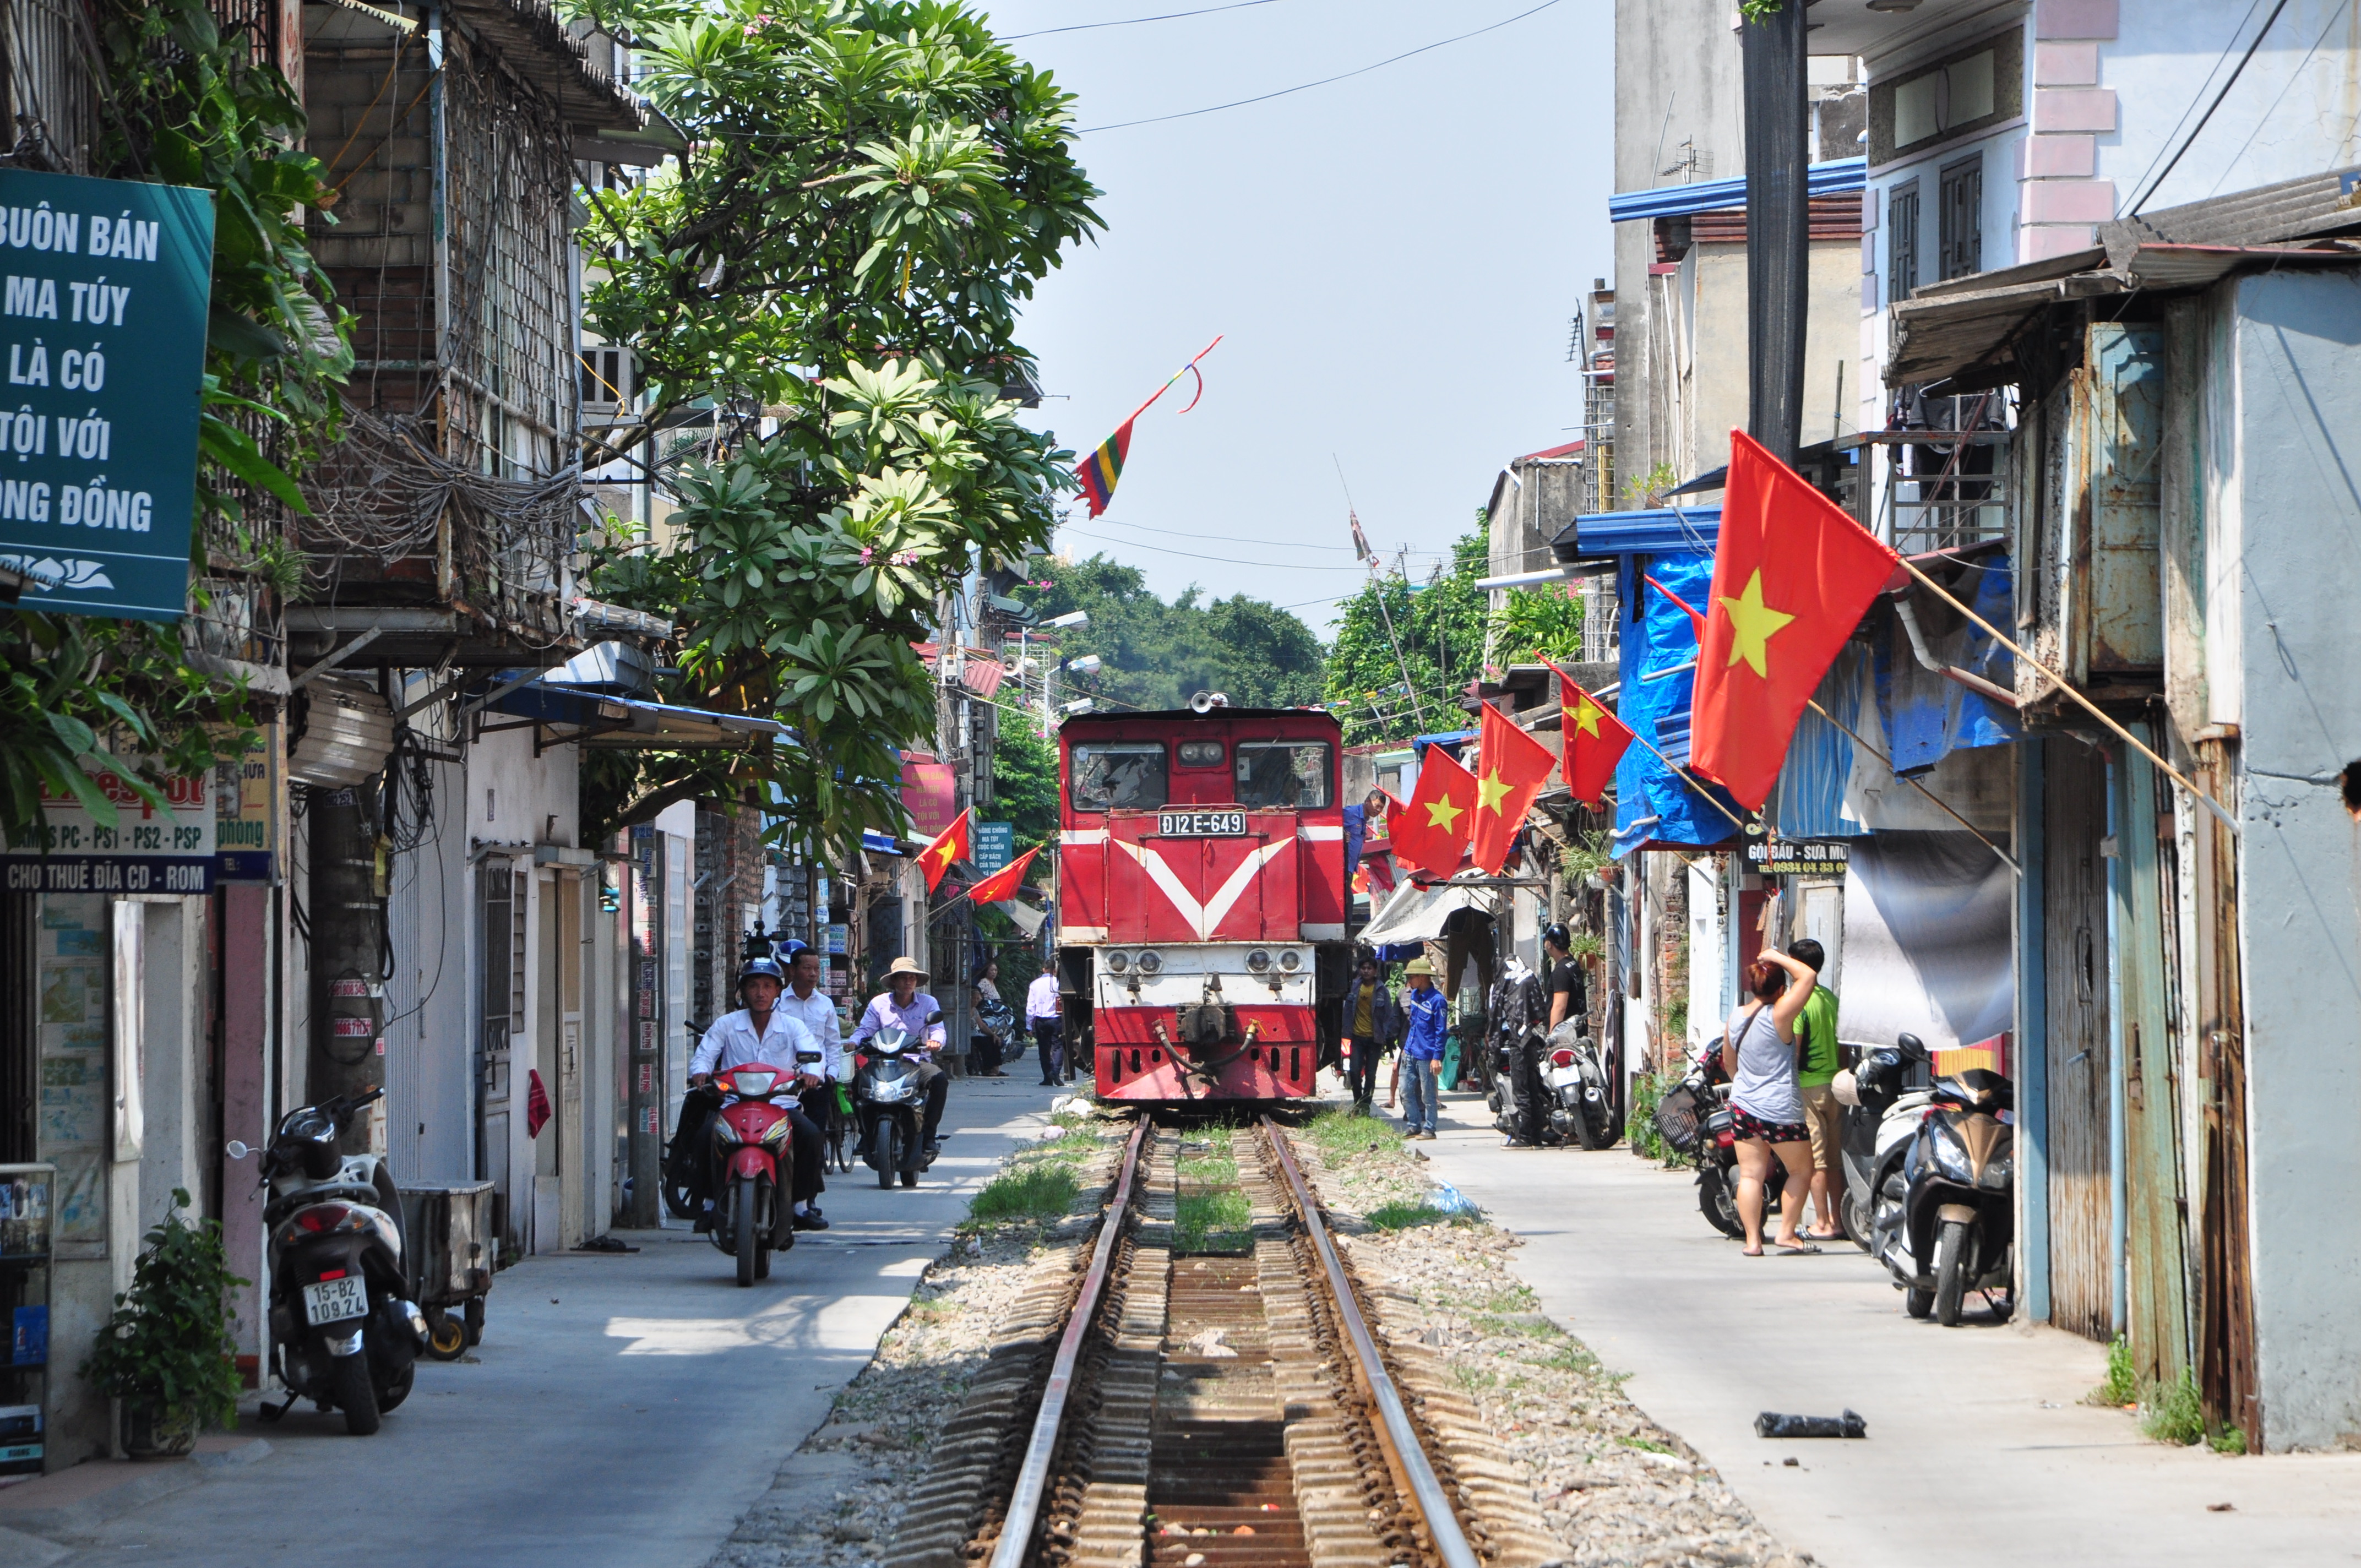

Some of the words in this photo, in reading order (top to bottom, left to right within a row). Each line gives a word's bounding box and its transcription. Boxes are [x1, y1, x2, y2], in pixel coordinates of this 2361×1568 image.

[89, 210, 159, 262] BÁN
[4, 275, 58, 320] MA
[70, 276, 130, 326] TÚY
[9, 337, 49, 386] LÀ
[61, 342, 105, 392] CÓ
[0, 404, 46, 461] TỘI
[58, 407, 110, 460] VỚI
[0, 480, 50, 523] NG
[60, 475, 152, 532] ĐỒNG
[62, 826, 80, 849] PC
[134, 826, 161, 850] PS2
[174, 826, 202, 850] PSP
[1748, 842, 1767, 863] GỘI
[1771, 841, 1794, 859] ĐẦU
[8, 864, 42, 889] CHO
[47, 859, 89, 889] THUÊ
[94, 860, 122, 889] ĐĨA
[127, 865, 150, 890] CD
[167, 865, 204, 890] ROM
[1773, 862, 1801, 873] 0934
[1803, 862, 1818, 873] 04
[1819, 862, 1834, 873] 33
[314, 1280, 356, 1302] 15-B2
[312, 1296, 365, 1322] 109.24
